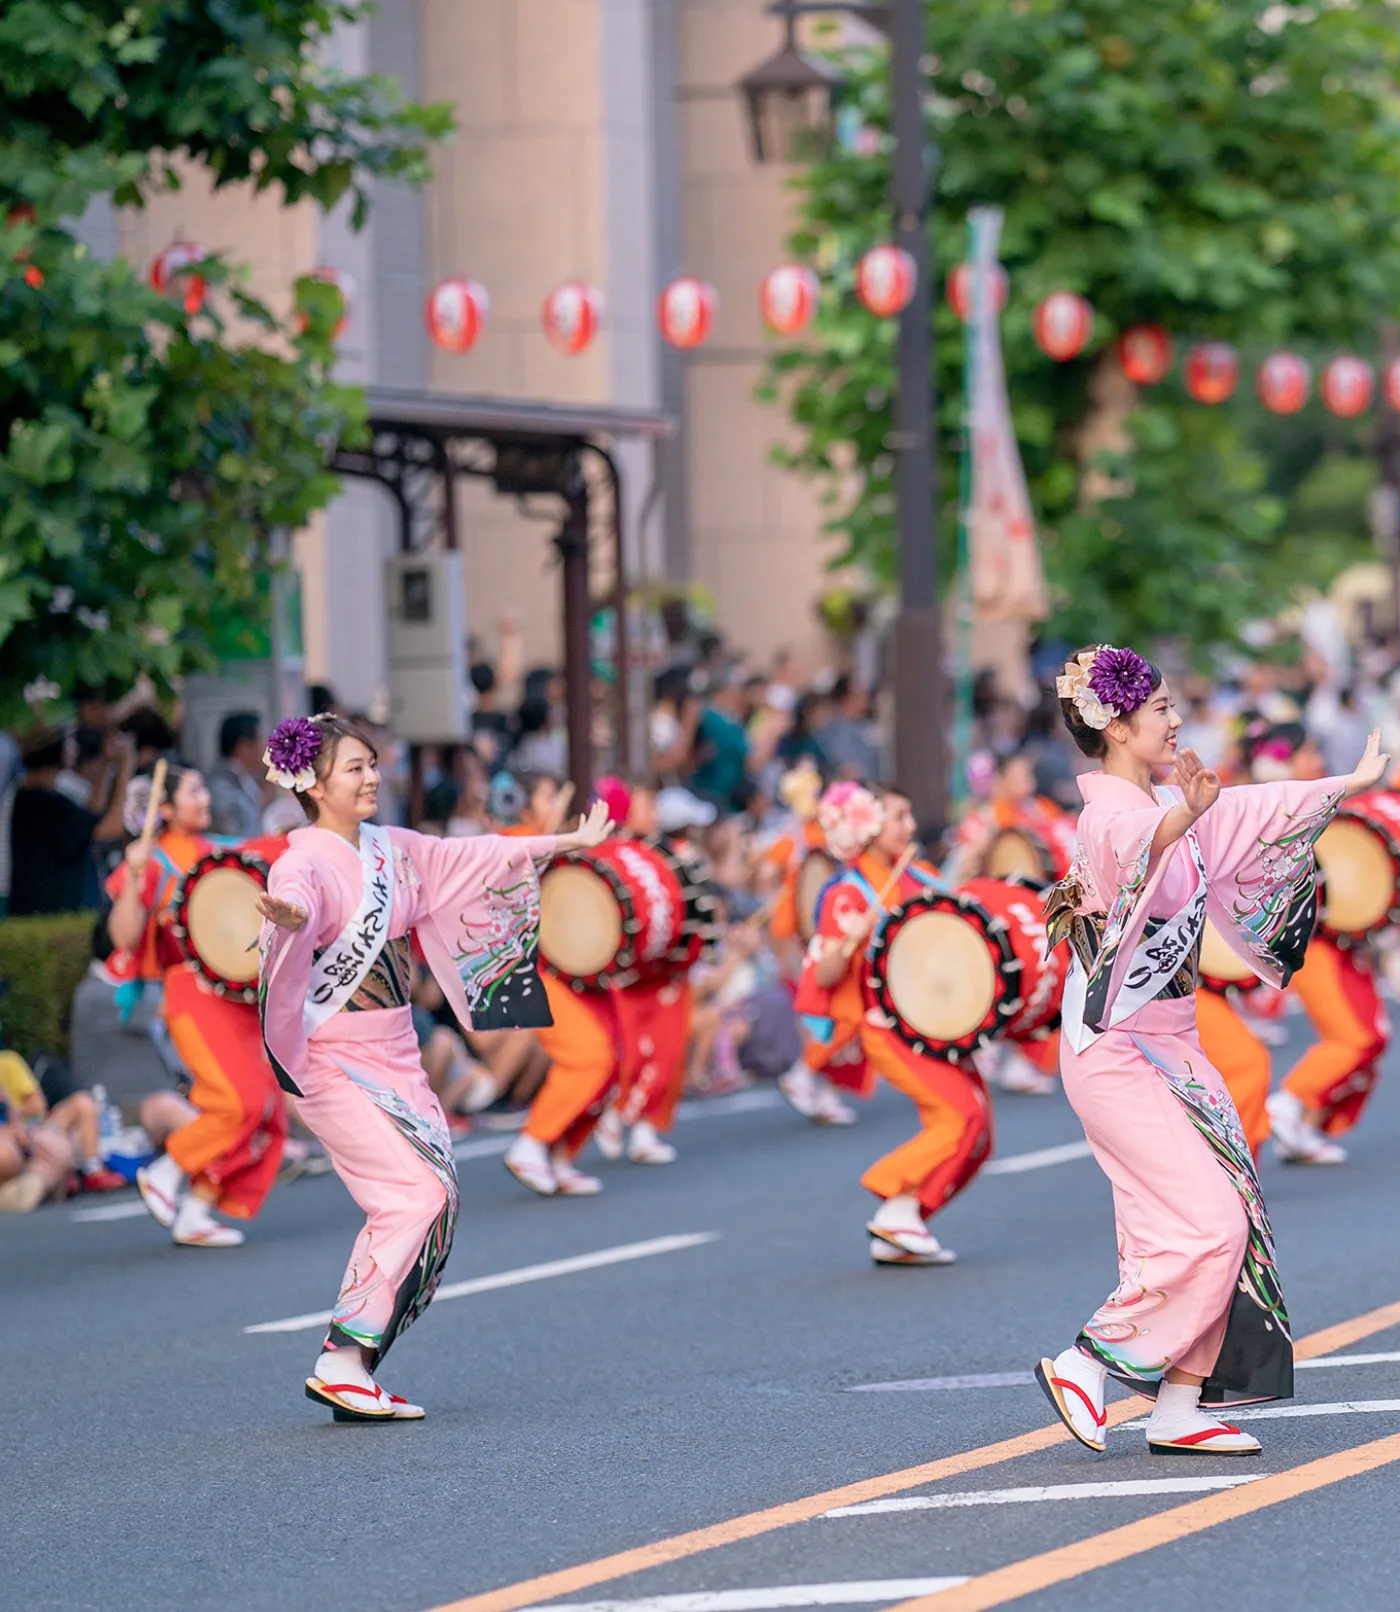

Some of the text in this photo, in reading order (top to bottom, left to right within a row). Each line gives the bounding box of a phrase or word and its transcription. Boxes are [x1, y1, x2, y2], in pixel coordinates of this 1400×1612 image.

[313, 837, 389, 1005] ミスさんさ踊り
